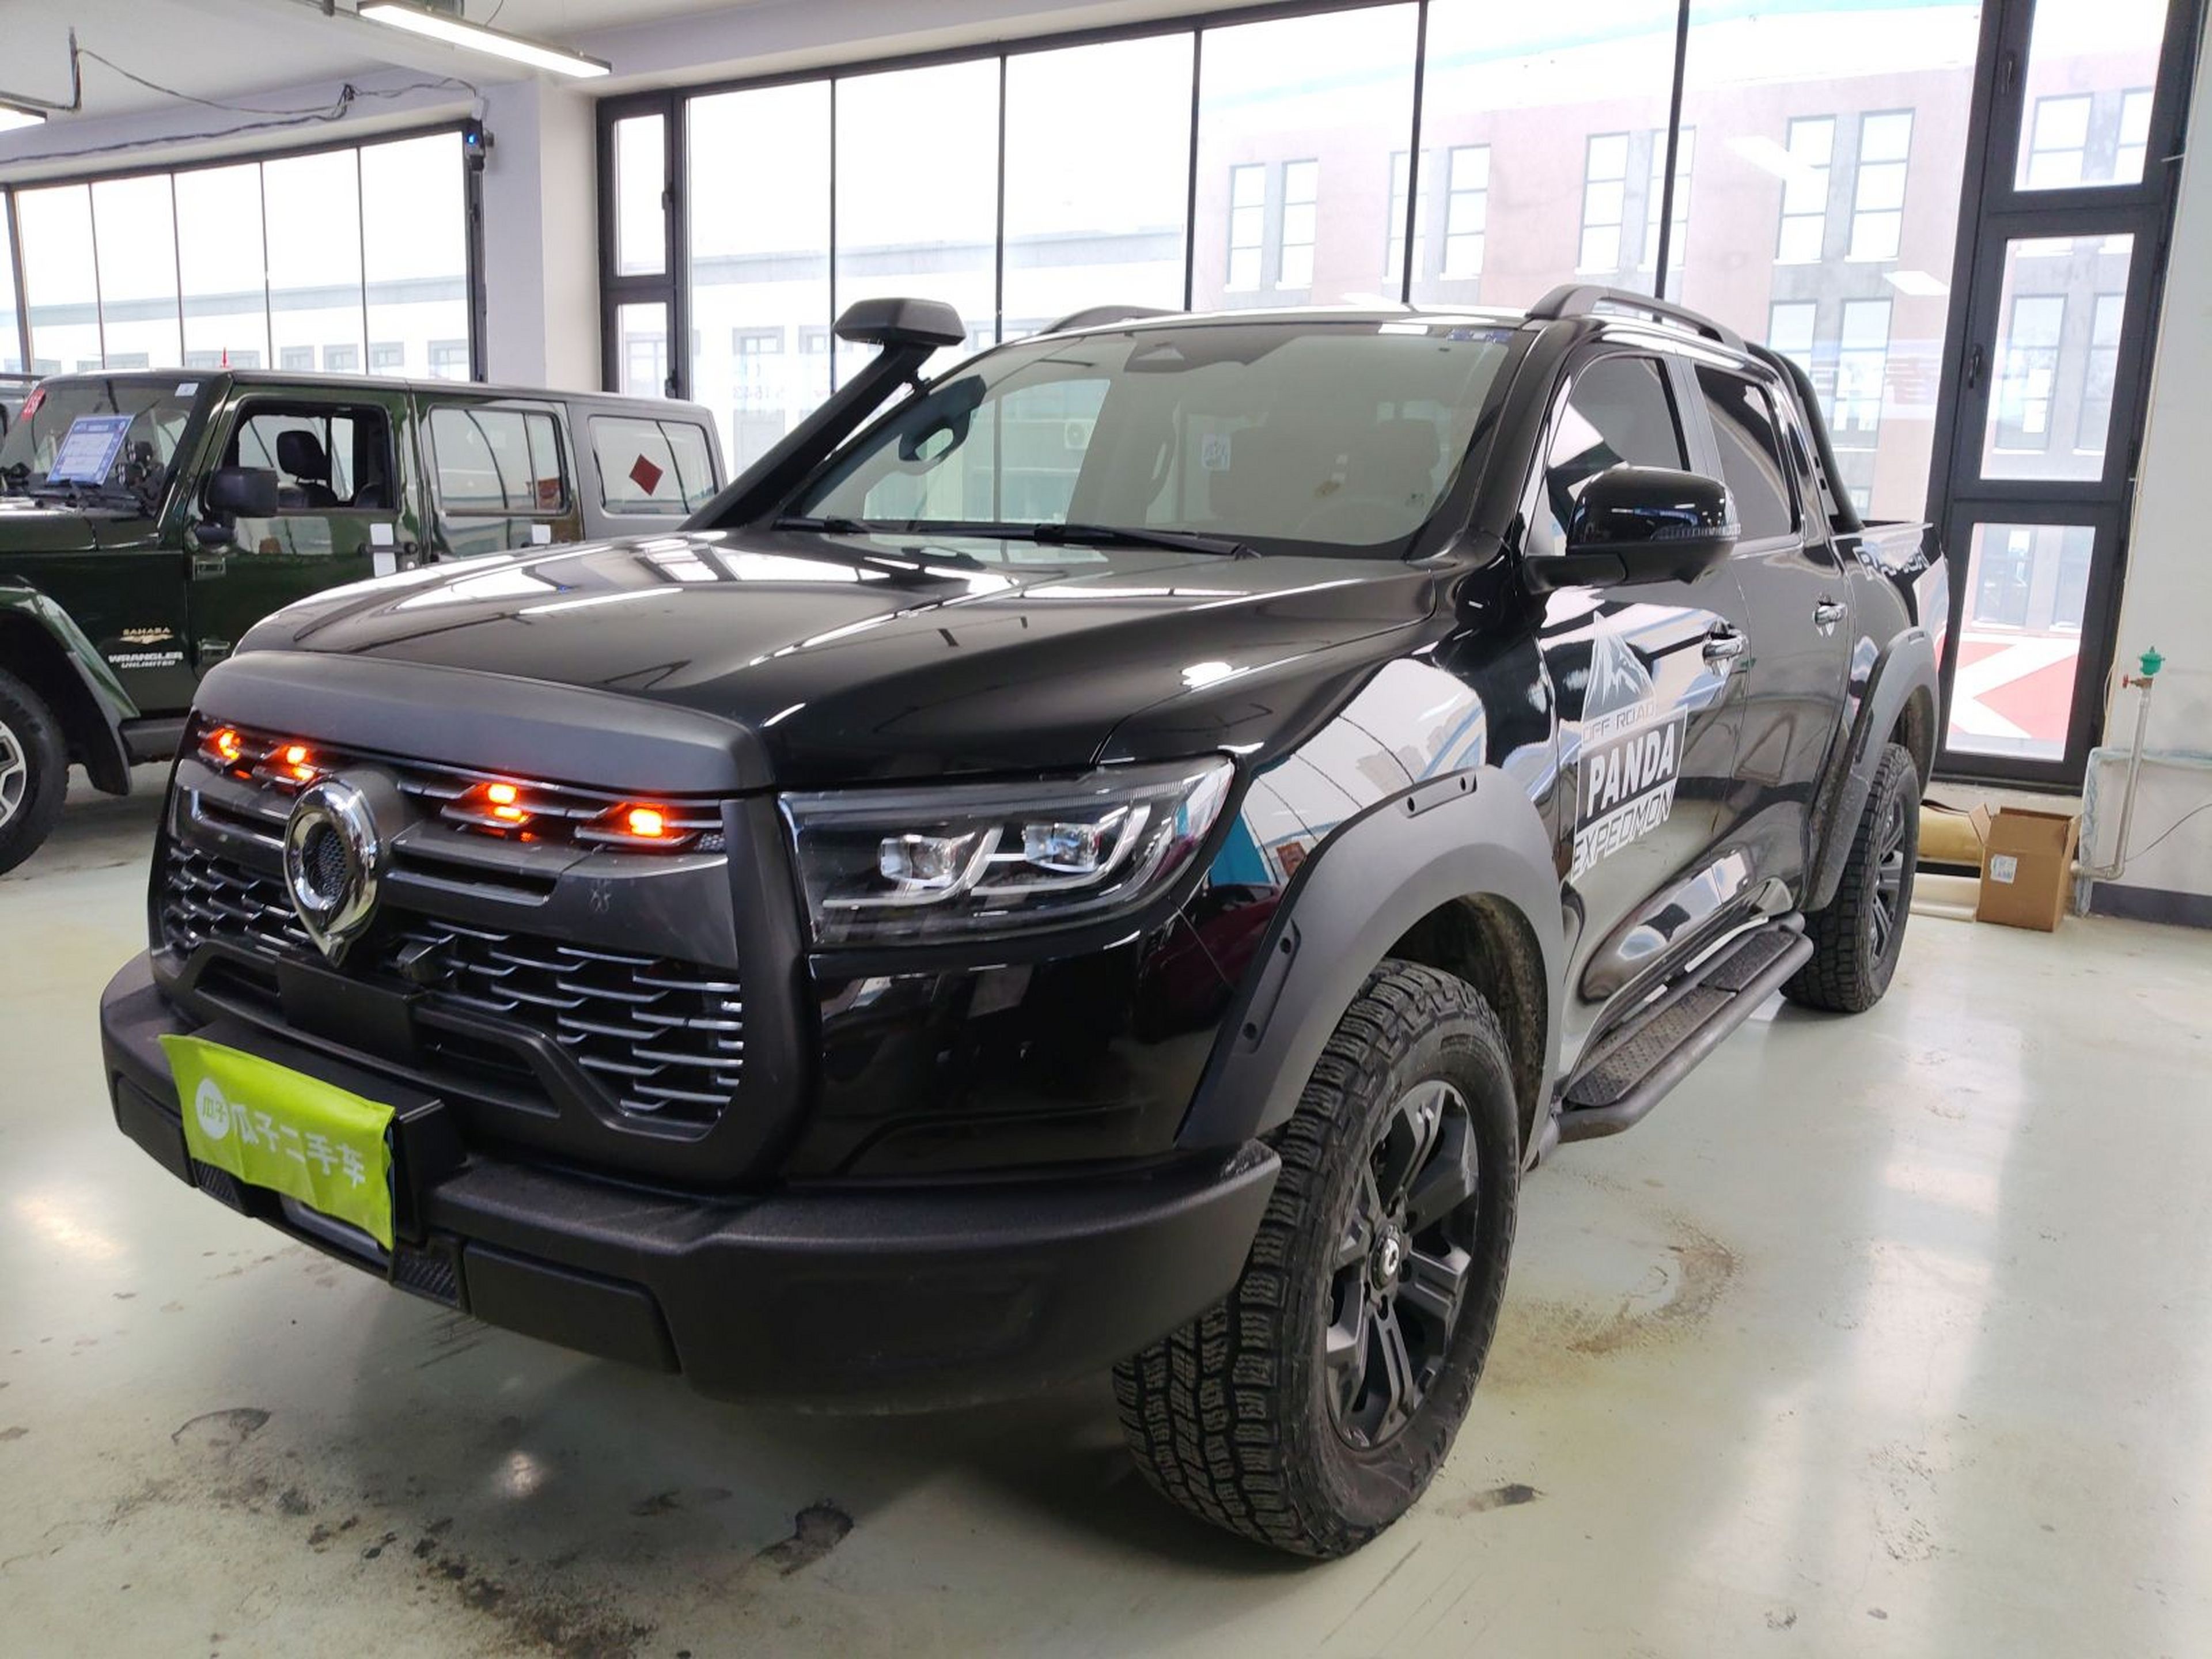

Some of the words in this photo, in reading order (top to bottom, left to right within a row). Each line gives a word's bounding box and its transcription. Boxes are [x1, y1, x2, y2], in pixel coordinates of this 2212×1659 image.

[108, 652, 184, 663] WRANGLER
[1586, 722, 1675, 819] PANDA
[231, 1103, 366, 1190] 瓜子二手车
